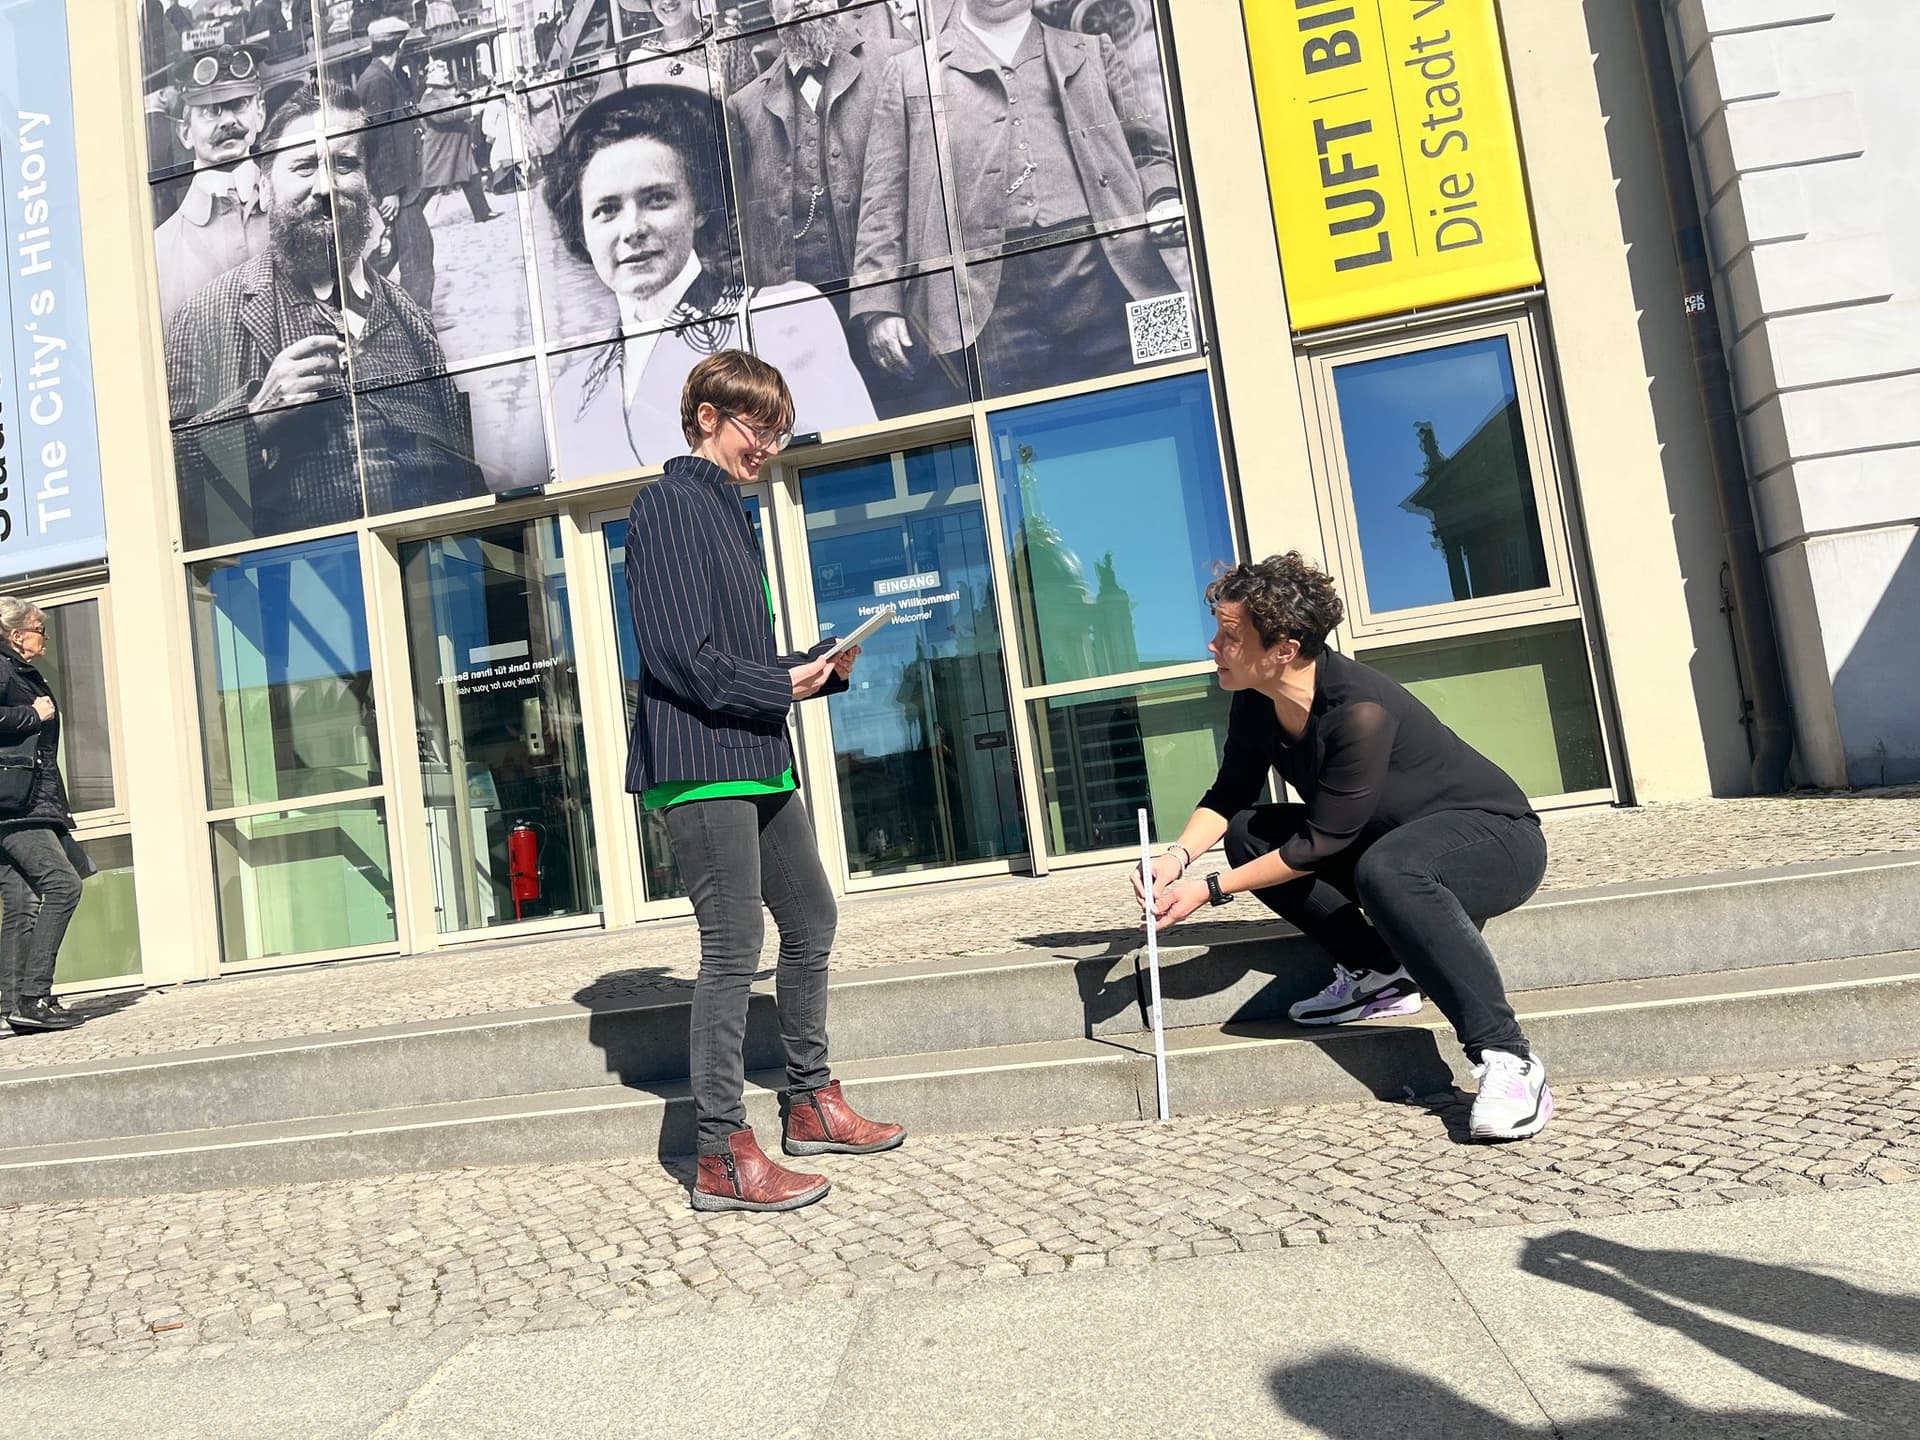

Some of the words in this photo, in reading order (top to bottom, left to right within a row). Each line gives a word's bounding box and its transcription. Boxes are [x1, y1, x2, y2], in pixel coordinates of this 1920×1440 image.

[1294, 0, 1362, 76] BI
[1404, 29, 1468, 159] Stadt
[17, 110, 52, 277] History
[1312, 117, 1393, 273] LUFT
[1429, 171, 1484, 253] Die
[1684, 294, 1704, 306] FCK
[1685, 302, 1705, 313] AFD
[36, 439, 72, 534] The
[858, 602, 897, 616] Herzlich
[898, 590, 961, 609] Willkommen!
[878, 574, 935, 594] EINGANG
[891, 610, 932, 625] Welcome!
